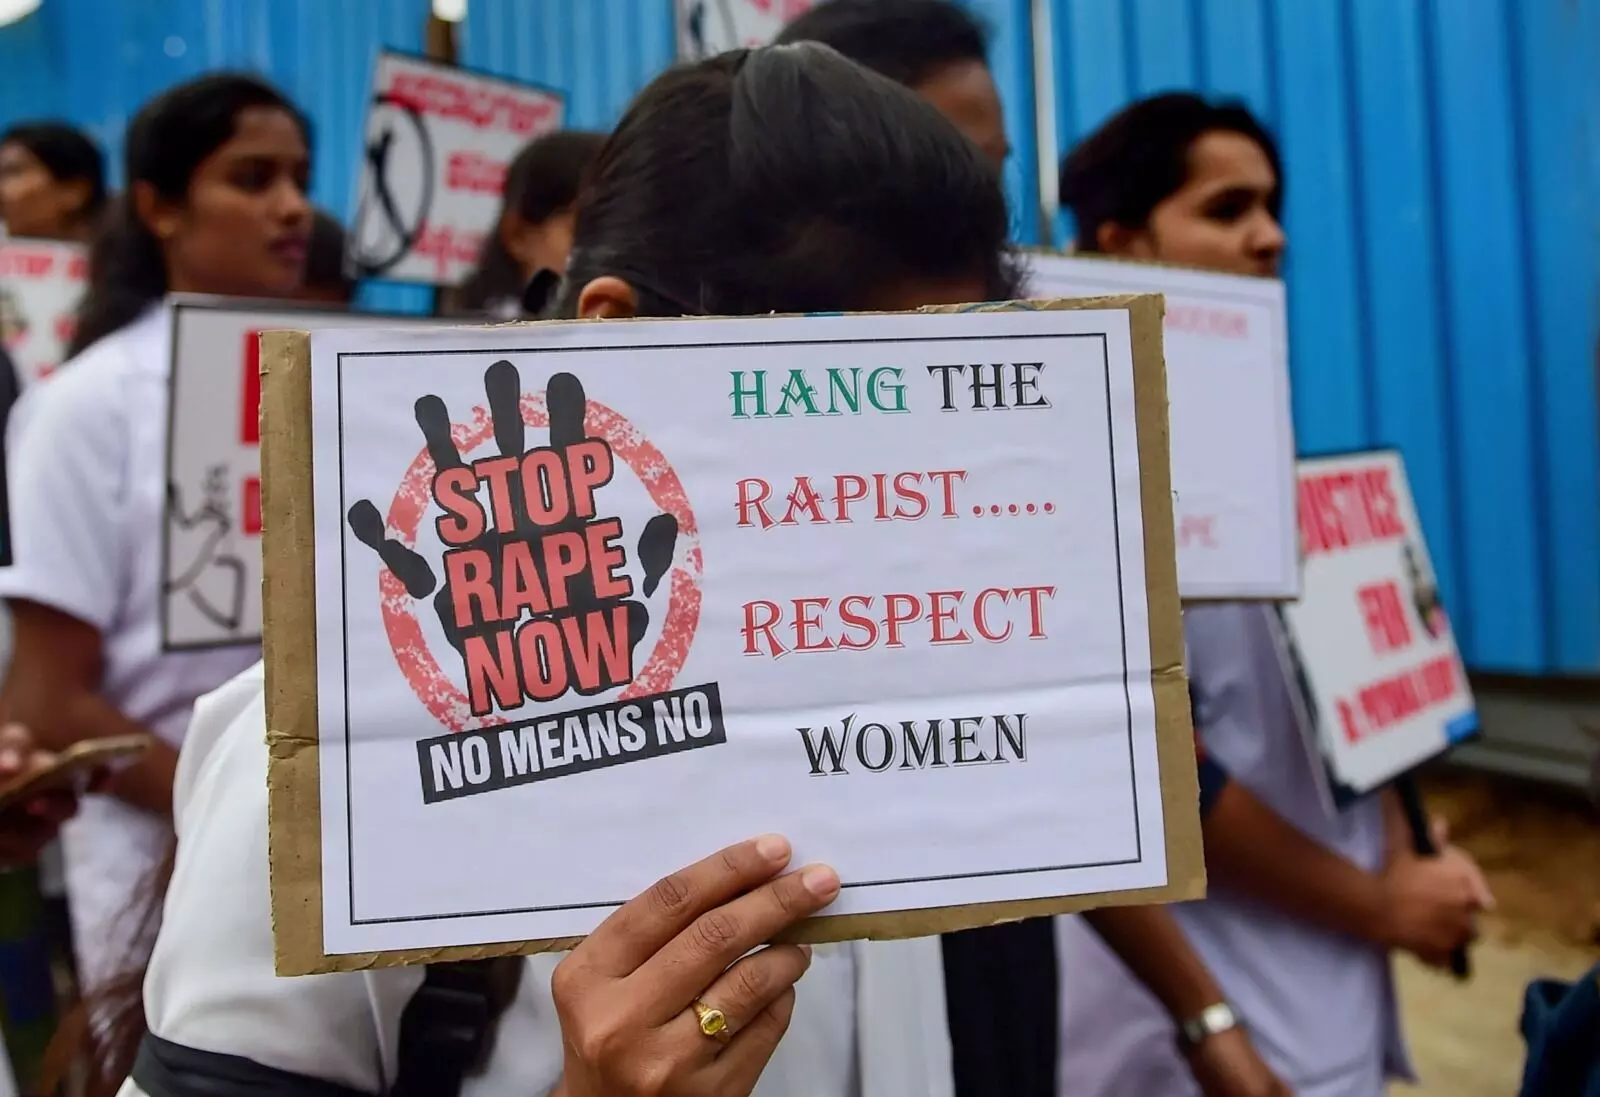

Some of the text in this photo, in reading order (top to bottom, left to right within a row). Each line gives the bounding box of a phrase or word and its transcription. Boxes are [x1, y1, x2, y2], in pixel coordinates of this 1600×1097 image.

[729, 362, 1052, 418] HANG THE
[433, 438, 613, 546] STOP
[444, 517, 632, 628] RAPE
[464, 602, 633, 715] NOW
[740, 586, 1057, 660] RESPECT
[429, 691, 712, 791] NO MEANS NO
[797, 712, 1030, 777] WOMEN
